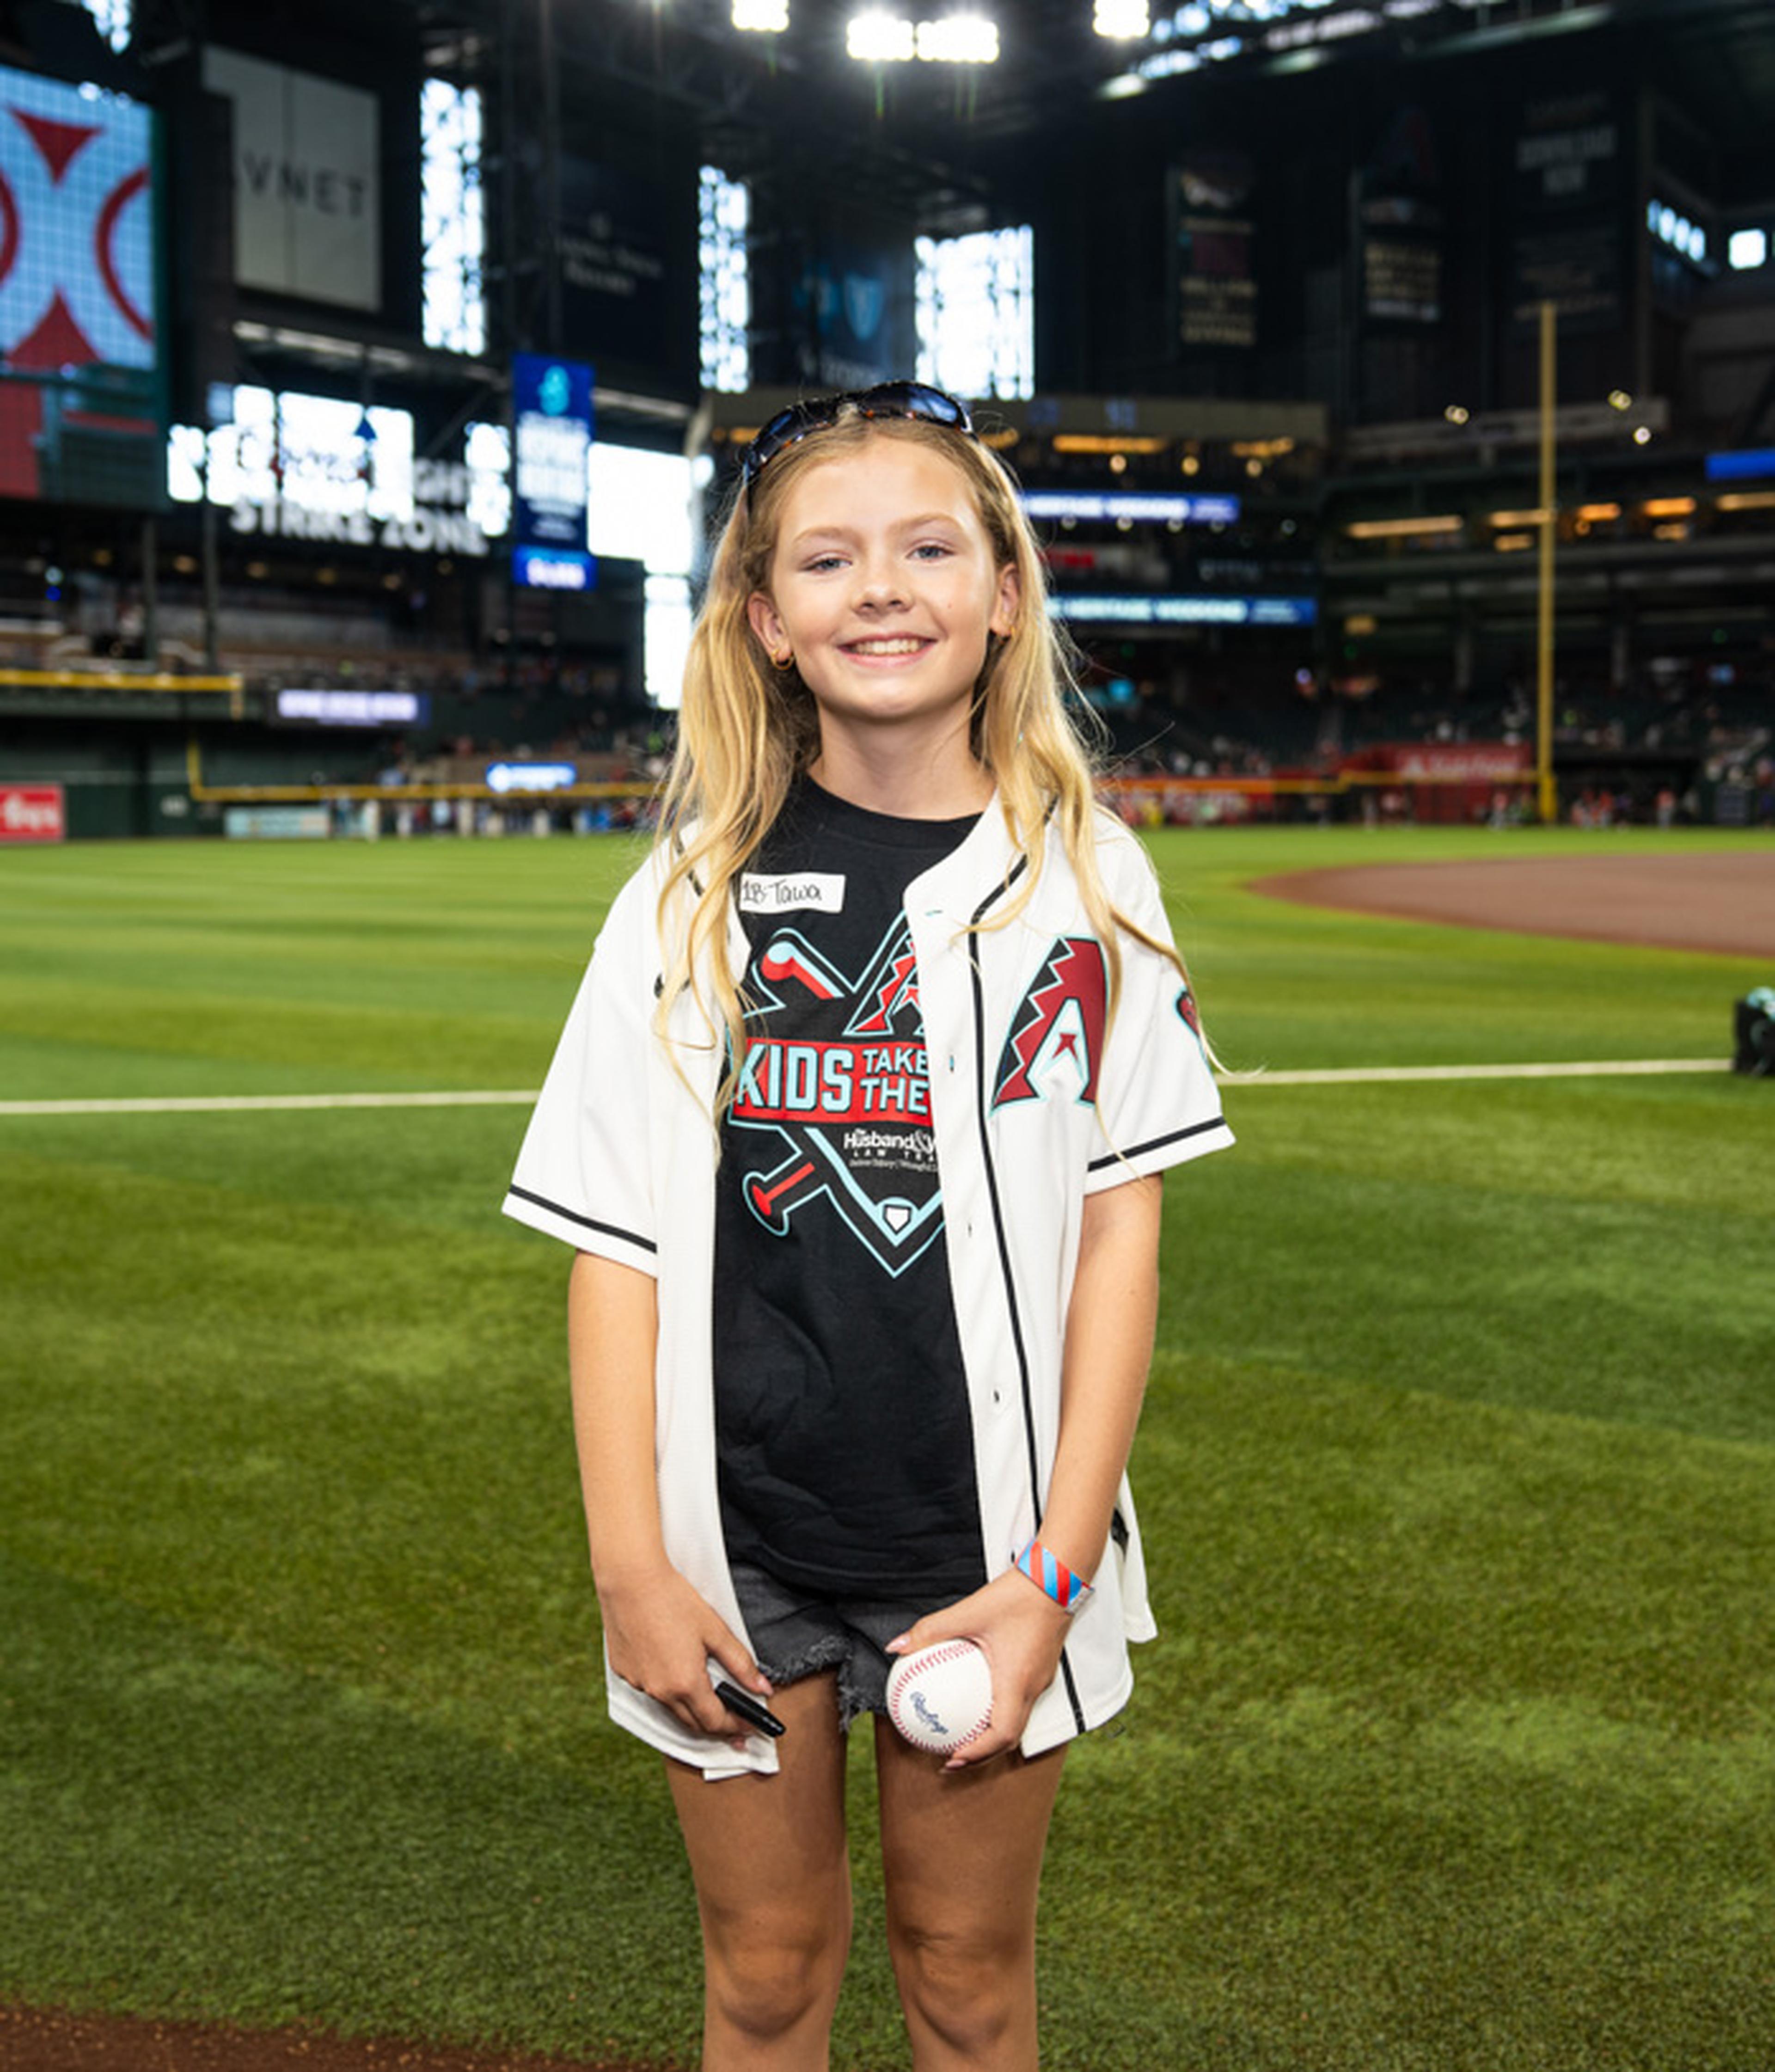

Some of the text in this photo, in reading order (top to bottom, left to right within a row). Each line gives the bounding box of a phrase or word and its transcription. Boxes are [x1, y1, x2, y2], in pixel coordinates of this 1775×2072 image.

[233, 150, 367, 217] VNET
[229, 496, 490, 557] STRIKE ZONE
[736, 1043, 929, 1113] KIDS TAKE
[860, 1077, 929, 1115] THE
